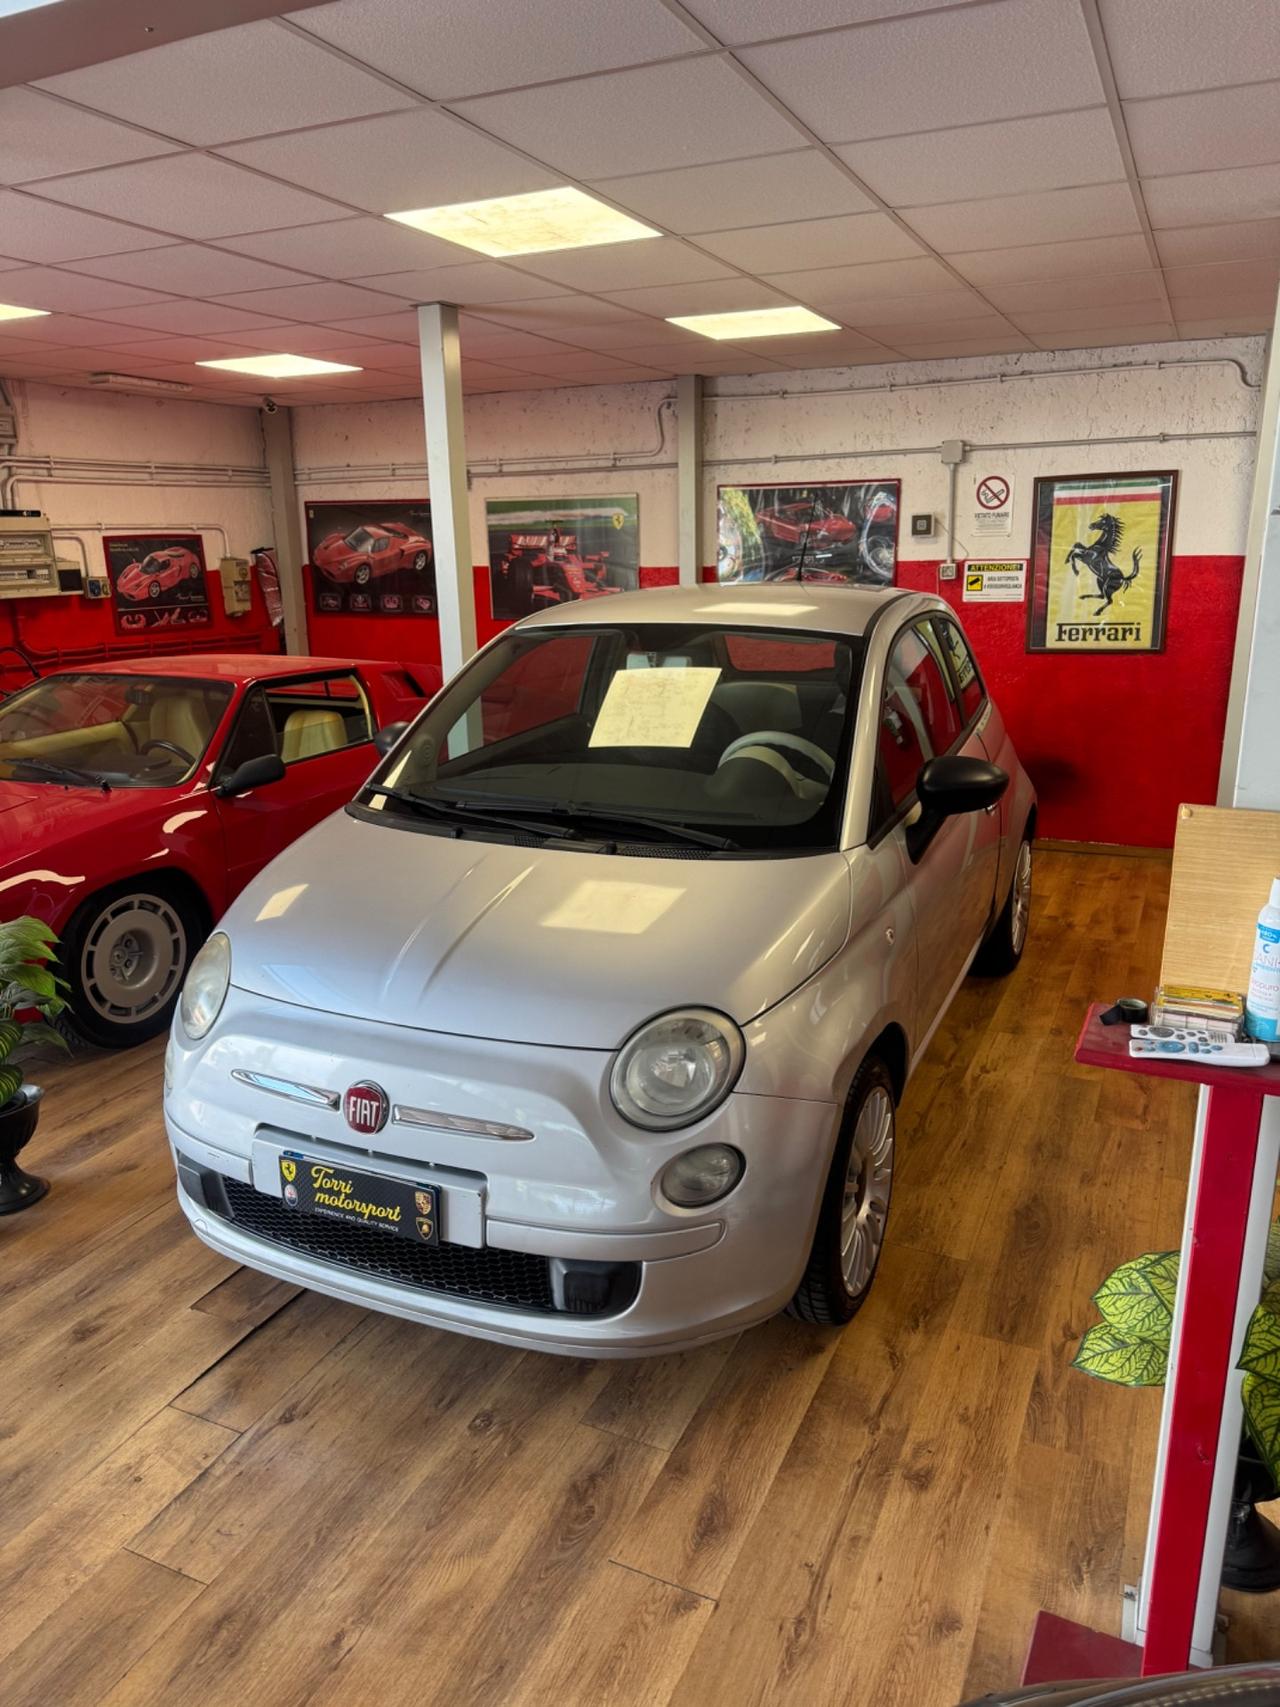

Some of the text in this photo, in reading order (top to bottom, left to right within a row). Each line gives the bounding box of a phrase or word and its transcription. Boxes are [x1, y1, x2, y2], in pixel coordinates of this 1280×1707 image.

[1055, 622, 1141, 641] Ferrari
[349, 1095, 380, 1127] FIAT
[311, 1166, 353, 1193] Torri
[315, 1192, 401, 1221] motorsport
